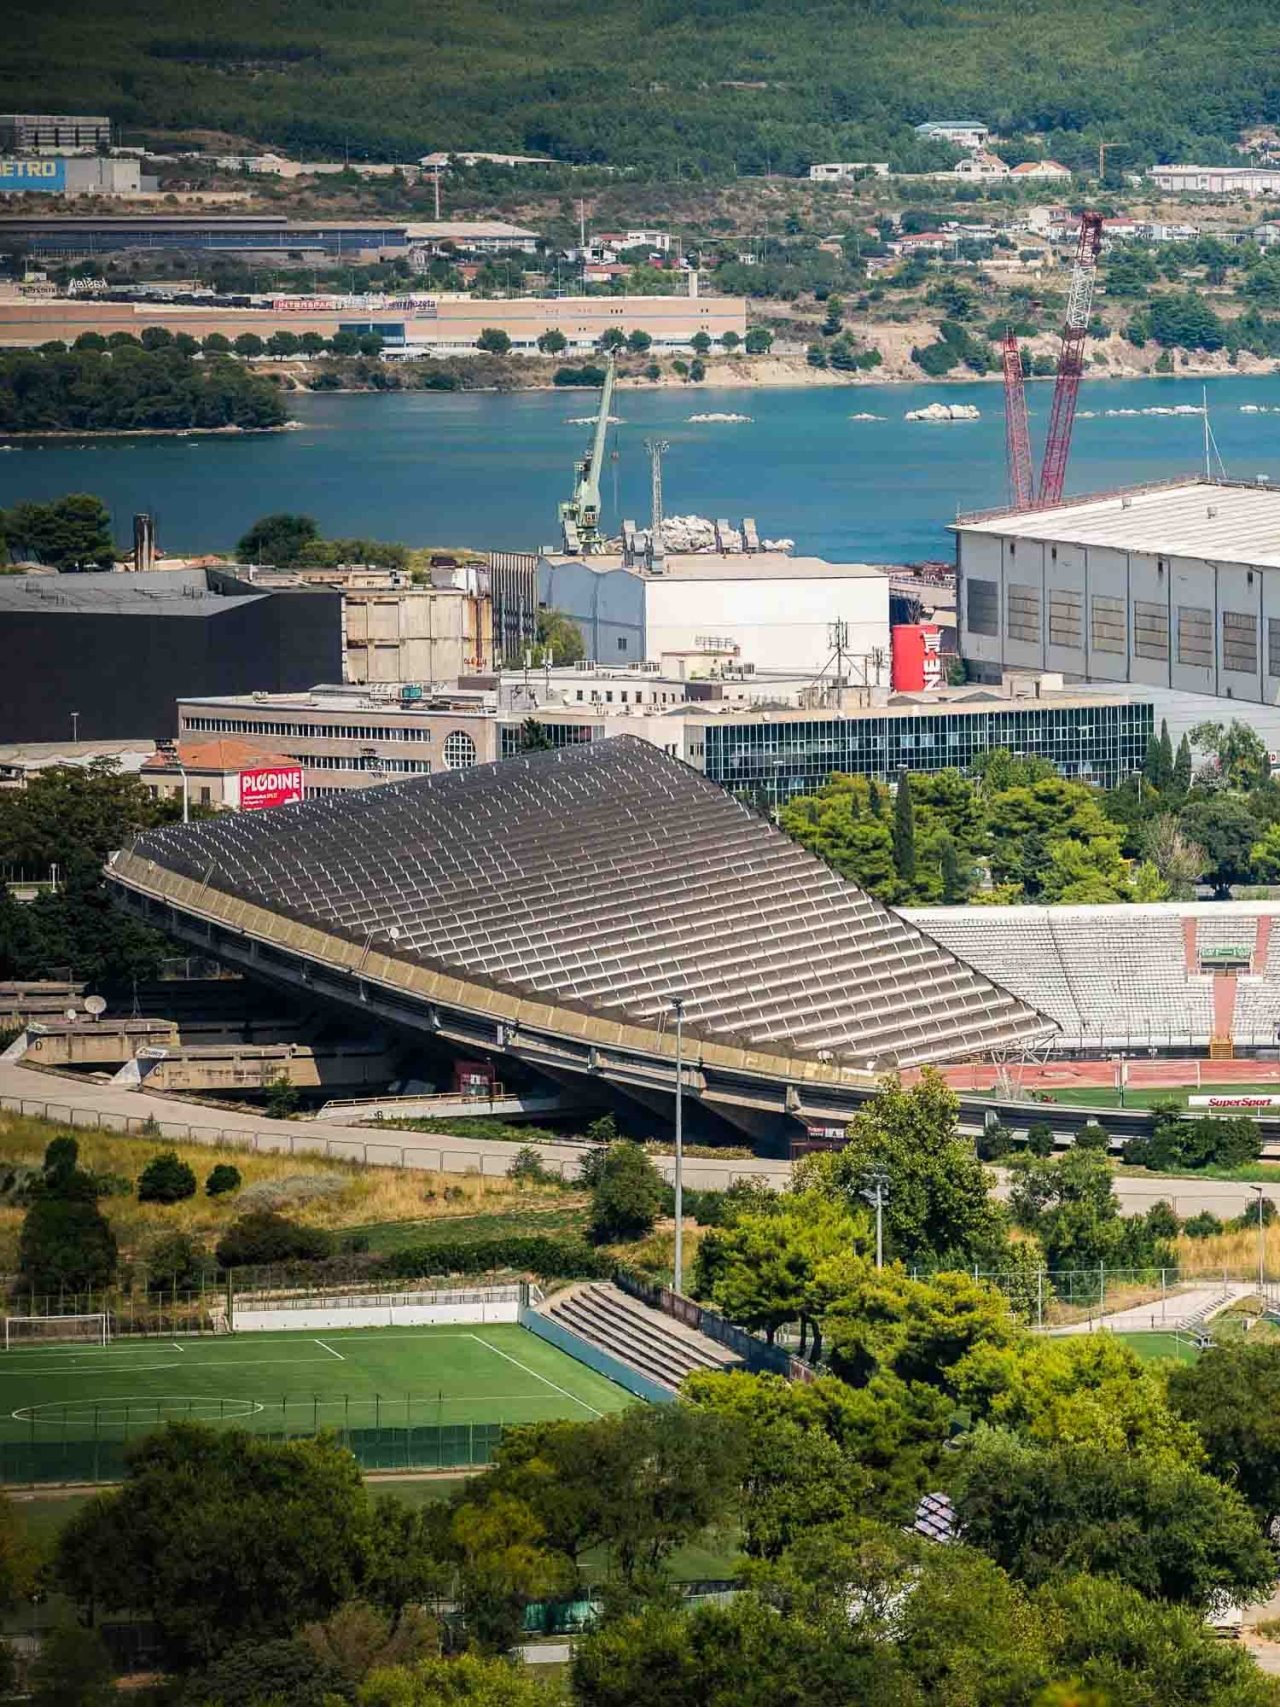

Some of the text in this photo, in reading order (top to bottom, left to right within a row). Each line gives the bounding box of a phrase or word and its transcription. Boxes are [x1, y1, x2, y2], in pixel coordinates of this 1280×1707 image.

[0, 161, 56, 176] ETRO
[242, 771, 300, 793] PLODINE
[1208, 1097, 1272, 1107] SuperSport
